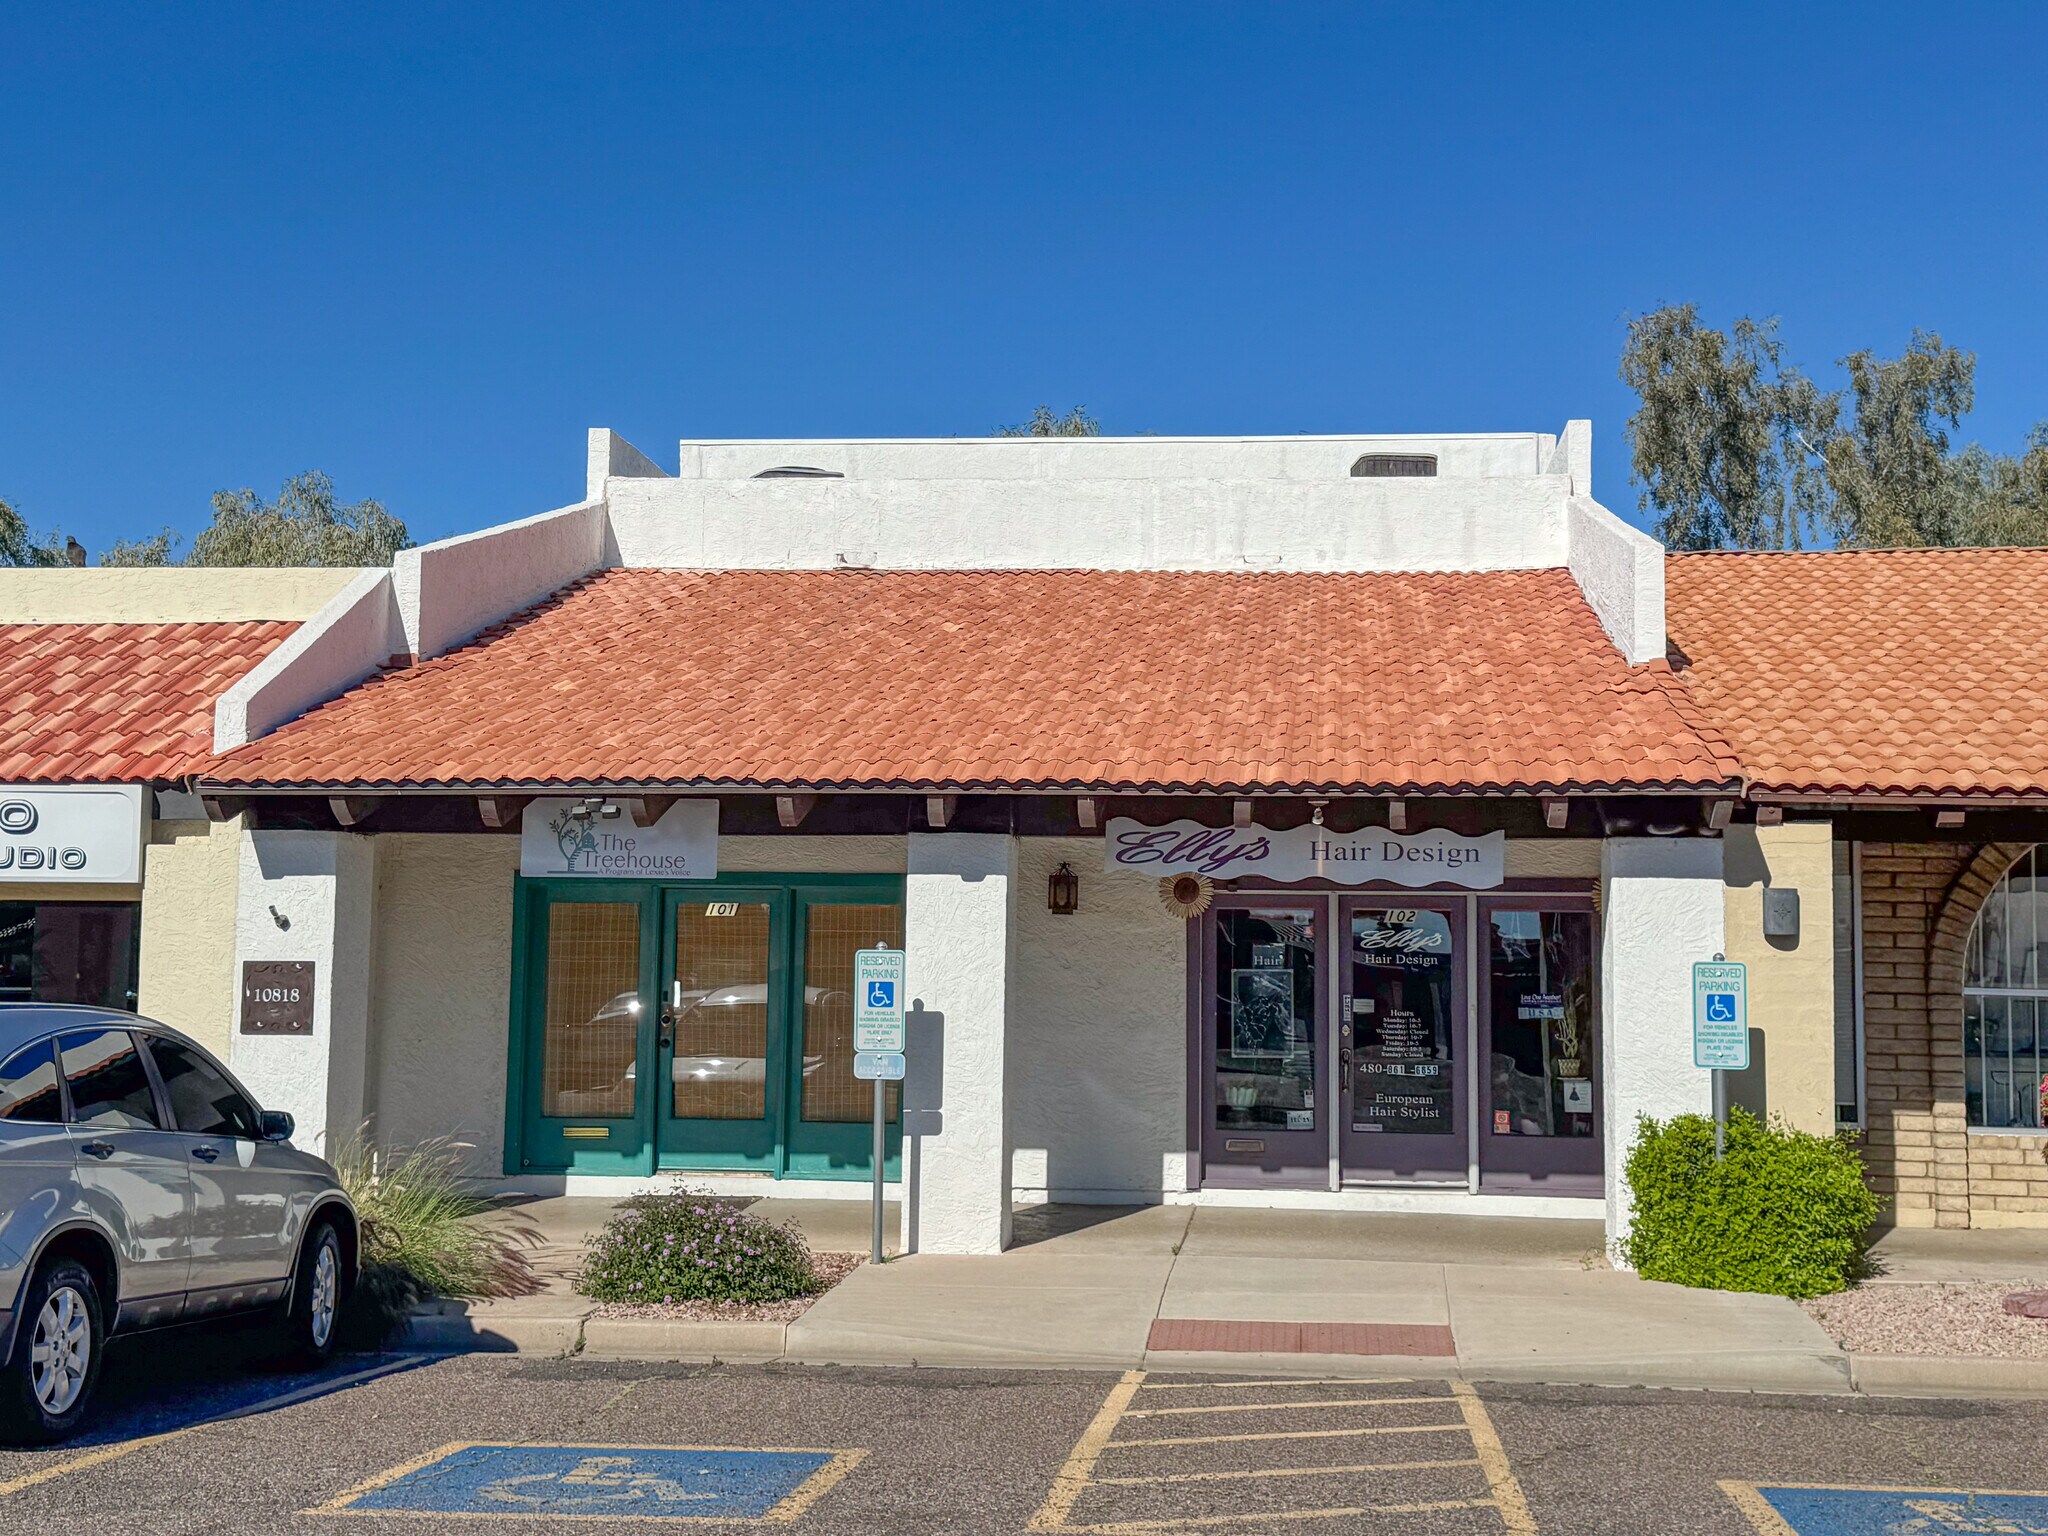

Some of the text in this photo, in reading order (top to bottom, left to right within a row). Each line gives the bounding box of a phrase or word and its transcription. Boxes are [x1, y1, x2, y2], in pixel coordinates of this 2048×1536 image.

[600, 833, 636, 851] The
[1115, 828, 1481, 873] Elly's Hair Design
[583, 850, 686, 869] Treehouse
[605, 868, 635, 877] Program
[636, 868, 644, 876] of
[645, 868, 670, 876] Lexie's
[671, 868, 691, 877] Voice
[709, 903, 735, 915] 101
[1388, 910, 1417, 922] 102
[1361, 929, 1442, 953] Elly's
[1254, 955, 1282, 966] Hair
[1365, 954, 1439, 967] Hair Design
[862, 969, 899, 978] PARKING
[1699, 981, 1741, 991] PARKING
[254, 988, 300, 1002] 10818
[1390, 1009, 1414, 1017] Hours
[1375, 1093, 1434, 1106] European
[1369, 1106, 1440, 1120] Hair Stylist
